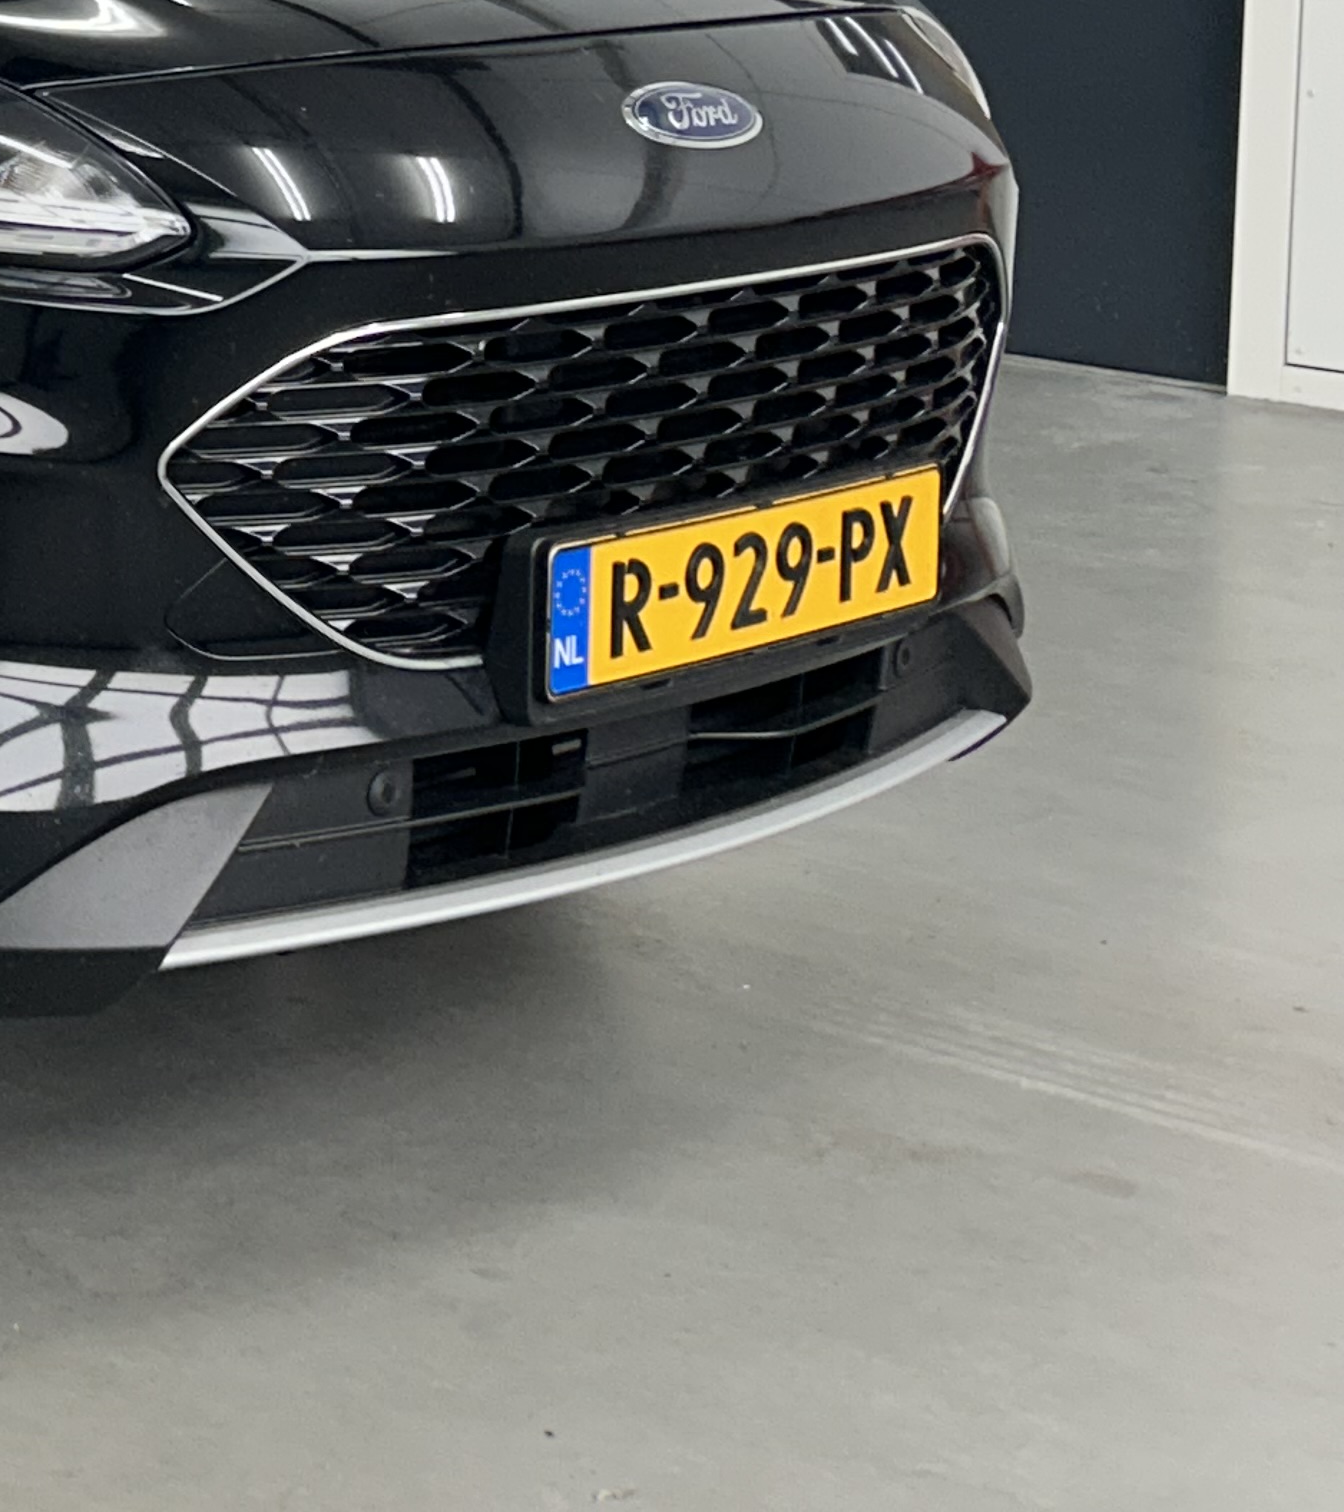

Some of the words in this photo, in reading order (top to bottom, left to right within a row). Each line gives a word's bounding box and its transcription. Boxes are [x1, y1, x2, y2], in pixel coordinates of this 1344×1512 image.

[660, 92, 739, 130] Ford
[610, 495, 914, 659] R-929-PX
[554, 638, 584, 668] NL
